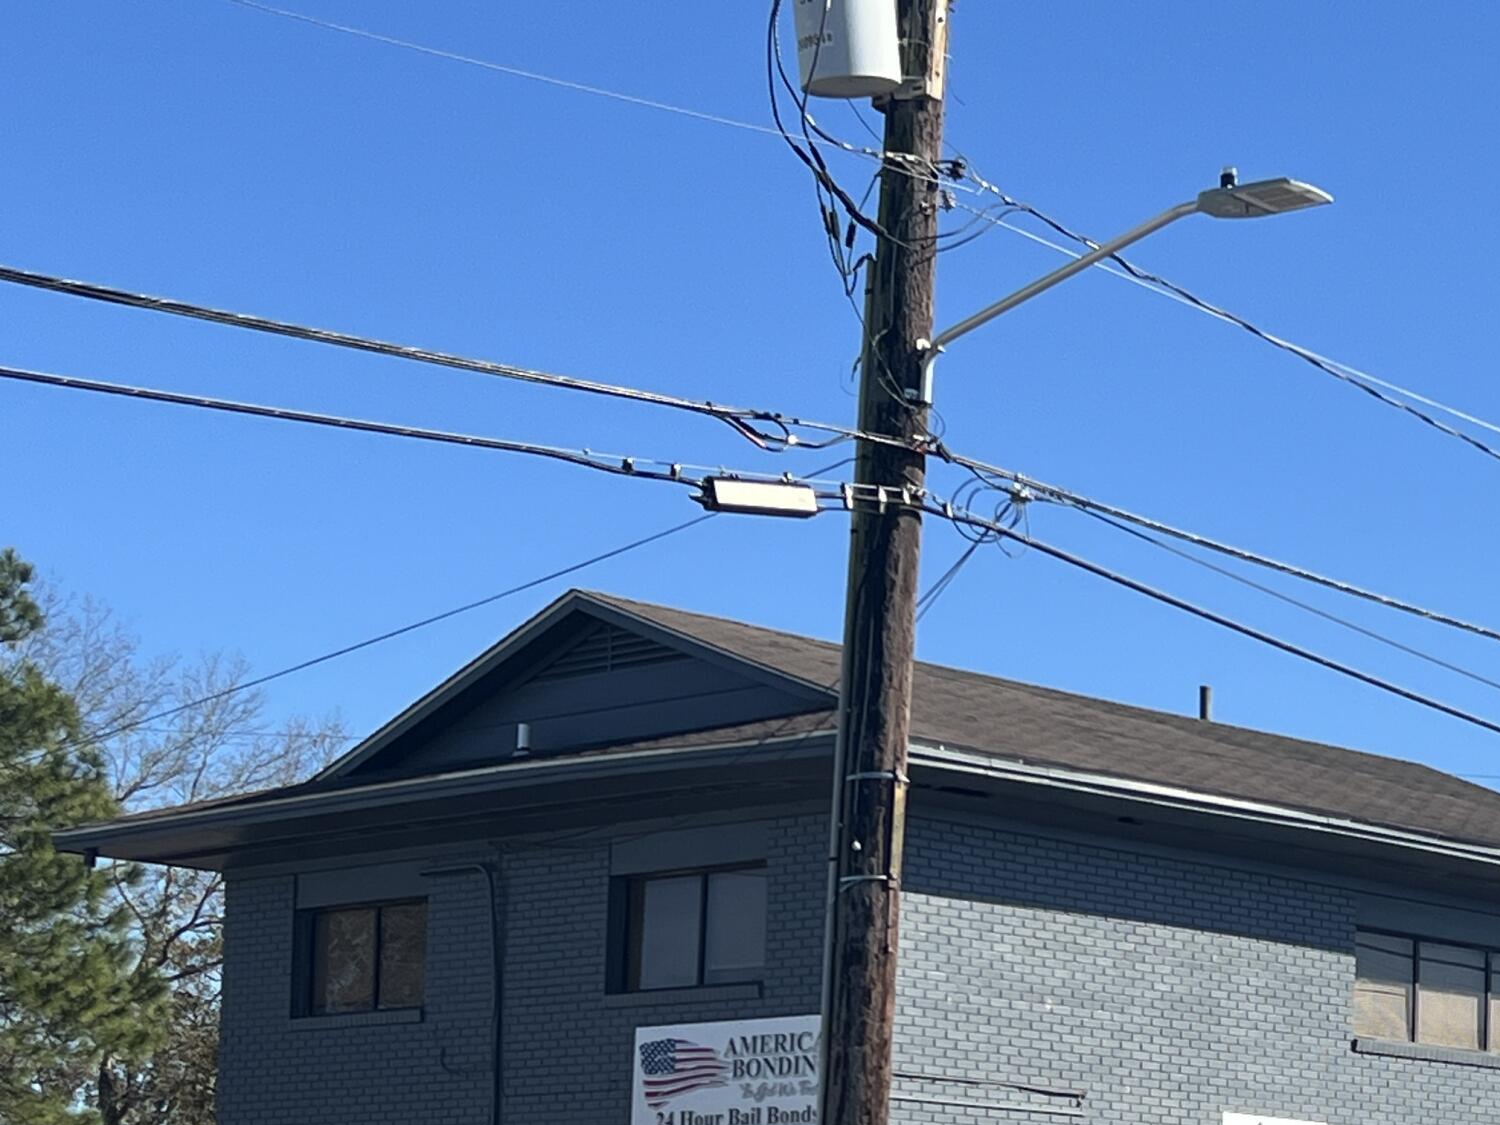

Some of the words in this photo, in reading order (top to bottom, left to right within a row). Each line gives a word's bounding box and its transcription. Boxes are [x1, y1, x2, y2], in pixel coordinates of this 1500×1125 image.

[723, 1031, 821, 1057] AMERIC
[732, 1054, 817, 1079] BONDIN
[728, 1107, 762, 1125] Bail
